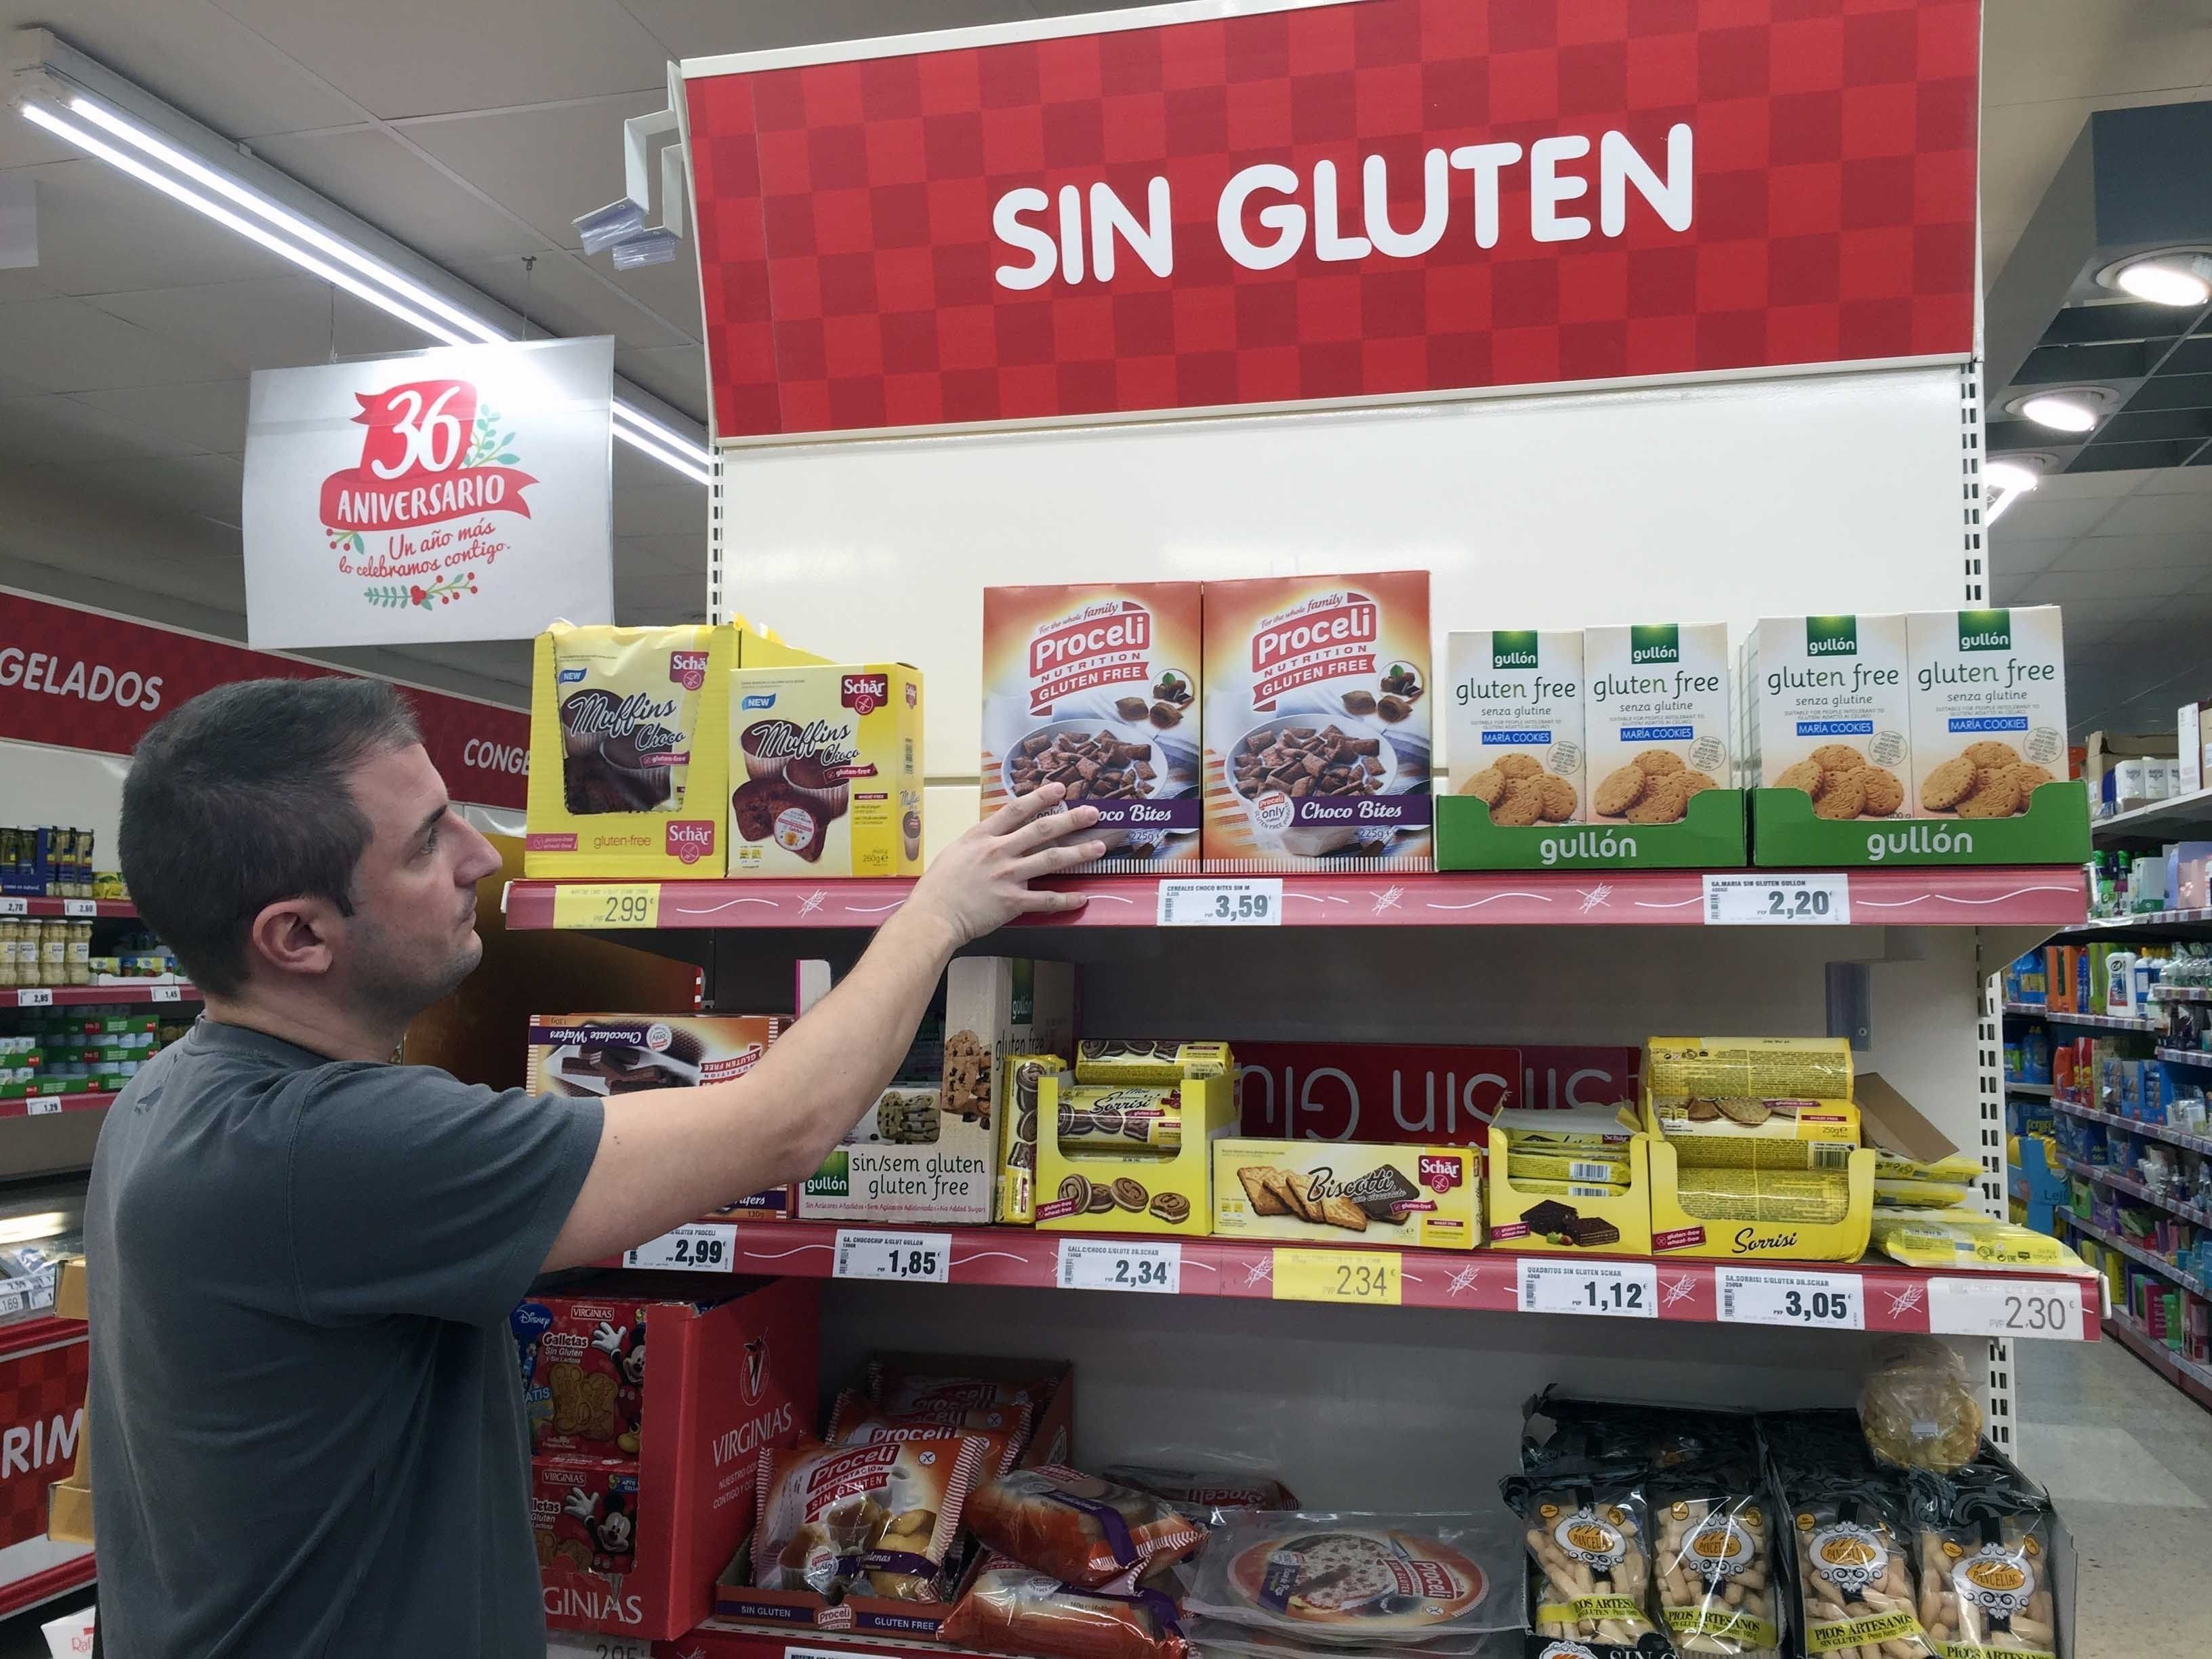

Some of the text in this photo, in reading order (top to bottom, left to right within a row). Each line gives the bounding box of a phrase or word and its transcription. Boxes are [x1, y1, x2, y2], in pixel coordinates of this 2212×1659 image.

[993, 123, 1692, 290] SIN GLUTEN
[371, 386, 461, 480] 36
[337, 475, 505, 525] ANIVERSARIO
[389, 517, 495, 560] Un año más
[339, 539, 510, 577] lo celebramos contigo.
[1084, 602, 1118, 620] family
[1307, 593, 1343, 613] family
[1036, 617, 1143, 670] Proceli
[1258, 608, 1370, 664] Proceli
[1961, 632, 2009, 650] gullón
[1633, 645, 1677, 662] gullón
[1809, 638, 1855, 655] gullón
[1041, 653, 1141, 683] NUTRITION
[1265, 645, 1367, 678] NUTRITION
[1494, 651, 1536, 667] gullón
[0, 647, 163, 712] GELADOS
[563, 672, 582, 680] NEW
[1039, 667, 1141, 700] GLUTEN FREE
[1262, 659, 1368, 696] GLUTEN FREE
[1767, 663, 1900, 695] gluten free
[1918, 658, 2055, 691] gluten free
[844, 679, 886, 697] Schär
[1456, 676, 1576, 705] gluten free
[1593, 670, 1719, 702] gluten free
[748, 699, 769, 707] NEW
[1795, 694, 1872, 708] senza glutine
[1947, 690, 2028, 703] senza glutine
[568, 692, 676, 737] Muffins
[1481, 706, 1551, 718] senza glutine
[1620, 701, 1693, 714] senza glutine
[1622, 727, 1692, 739] MARÍA COOKIES
[1799, 722, 1872, 733] MARÍA COOKIES
[1950, 718, 2026, 730] MARÍA COOKIES
[636, 723, 686, 751] Choco
[752, 719, 851, 760] Muffins
[1483, 732, 1550, 742] MARÍA COOKIES
[464, 737, 530, 776] CONGE
[652, 755, 685, 764] gluten-free
[821, 743, 860, 766] Choco
[836, 768, 871, 777] gluten-free
[1097, 804, 1172, 822] oco Bites
[1262, 806, 1285, 819] only
[1301, 800, 1402, 819] Choco Bites
[594, 834, 651, 849] gluten-free
[669, 825, 712, 845] Schär
[1359, 830, 1383, 839] 225g
[1867, 823, 1973, 861] gullón
[1539, 826, 1637, 865] gullón
[863, 855, 882, 863] 260g
[1215, 895, 1268, 922] 3,59
[1768, 890, 1830, 920] 2,20
[550, 1029, 642, 1044] Chocolate Wafers
[704, 1052, 757, 1071] GLUTEN FREE
[1089, 1097, 1152, 1114] Sorrisi
[1822, 1126, 1840, 1134] 250g
[852, 1153, 985, 1179] sin/sem gluten
[1421, 1159, 1460, 1178] Schär
[807, 1176, 847, 1193] gullón
[869, 1174, 969, 1201] gluten free
[1306, 1166, 1394, 1204] Biscotti
[1044, 1201, 1072, 1212] gluten-free
[1044, 1207, 1072, 1218] wheat-free
[1401, 1202, 1432, 1210] gluten-free
[1667, 1230, 1700, 1240] gluten-free
[1667, 1235, 1700, 1246] wheat-free
[1732, 1227, 1797, 1254] Sorrisi
[675, 1239, 722, 1266] 2,99
[889, 1250, 936, 1277] 1,85
[1528, 1267, 1561, 1275] QUADRITOS
[1115, 1260, 1167, 1287] 2,34
[1763, 1277, 1795, 1285] S/GLUTEN
[1584, 1281, 1642, 1311] 1,12
[573, 1308, 613, 1319] VIRGINIAS
[1786, 1291, 1847, 1322] 3,05
[516, 1309, 550, 1328] Disney
[544, 1334, 588, 1347] Galletas
[545, 1347, 583, 1357] Sin Gluten
[712, 1402, 792, 1468] VIRGINIAS
[873, 1427, 951, 1442] Proceli
[814, 1445, 898, 1486] Proceli
[544, 1471, 585, 1484] VIRGINIAS
[718, 1468, 745, 1491] NUESTRO
[713, 1485, 739, 1509] CONTIGO
[812, 1476, 882, 1511] SIN GLUTEN
[1416, 1561, 1450, 1599] Proceli
[543, 1586, 643, 1624] GINIAS
[741, 1605, 791, 1618] SIN GLUTEN
[819, 1606, 851, 1622] Proceli
[874, 1617, 935, 1631] GLUTEN FREE
[1668, 1610, 1694, 1622] PICOS
[1815, 1614, 1913, 1640] PICOS ARTESANOS
[1833, 1635, 1864, 1646] GLUTEN
[1947, 1646, 1981, 1659] PICOS
